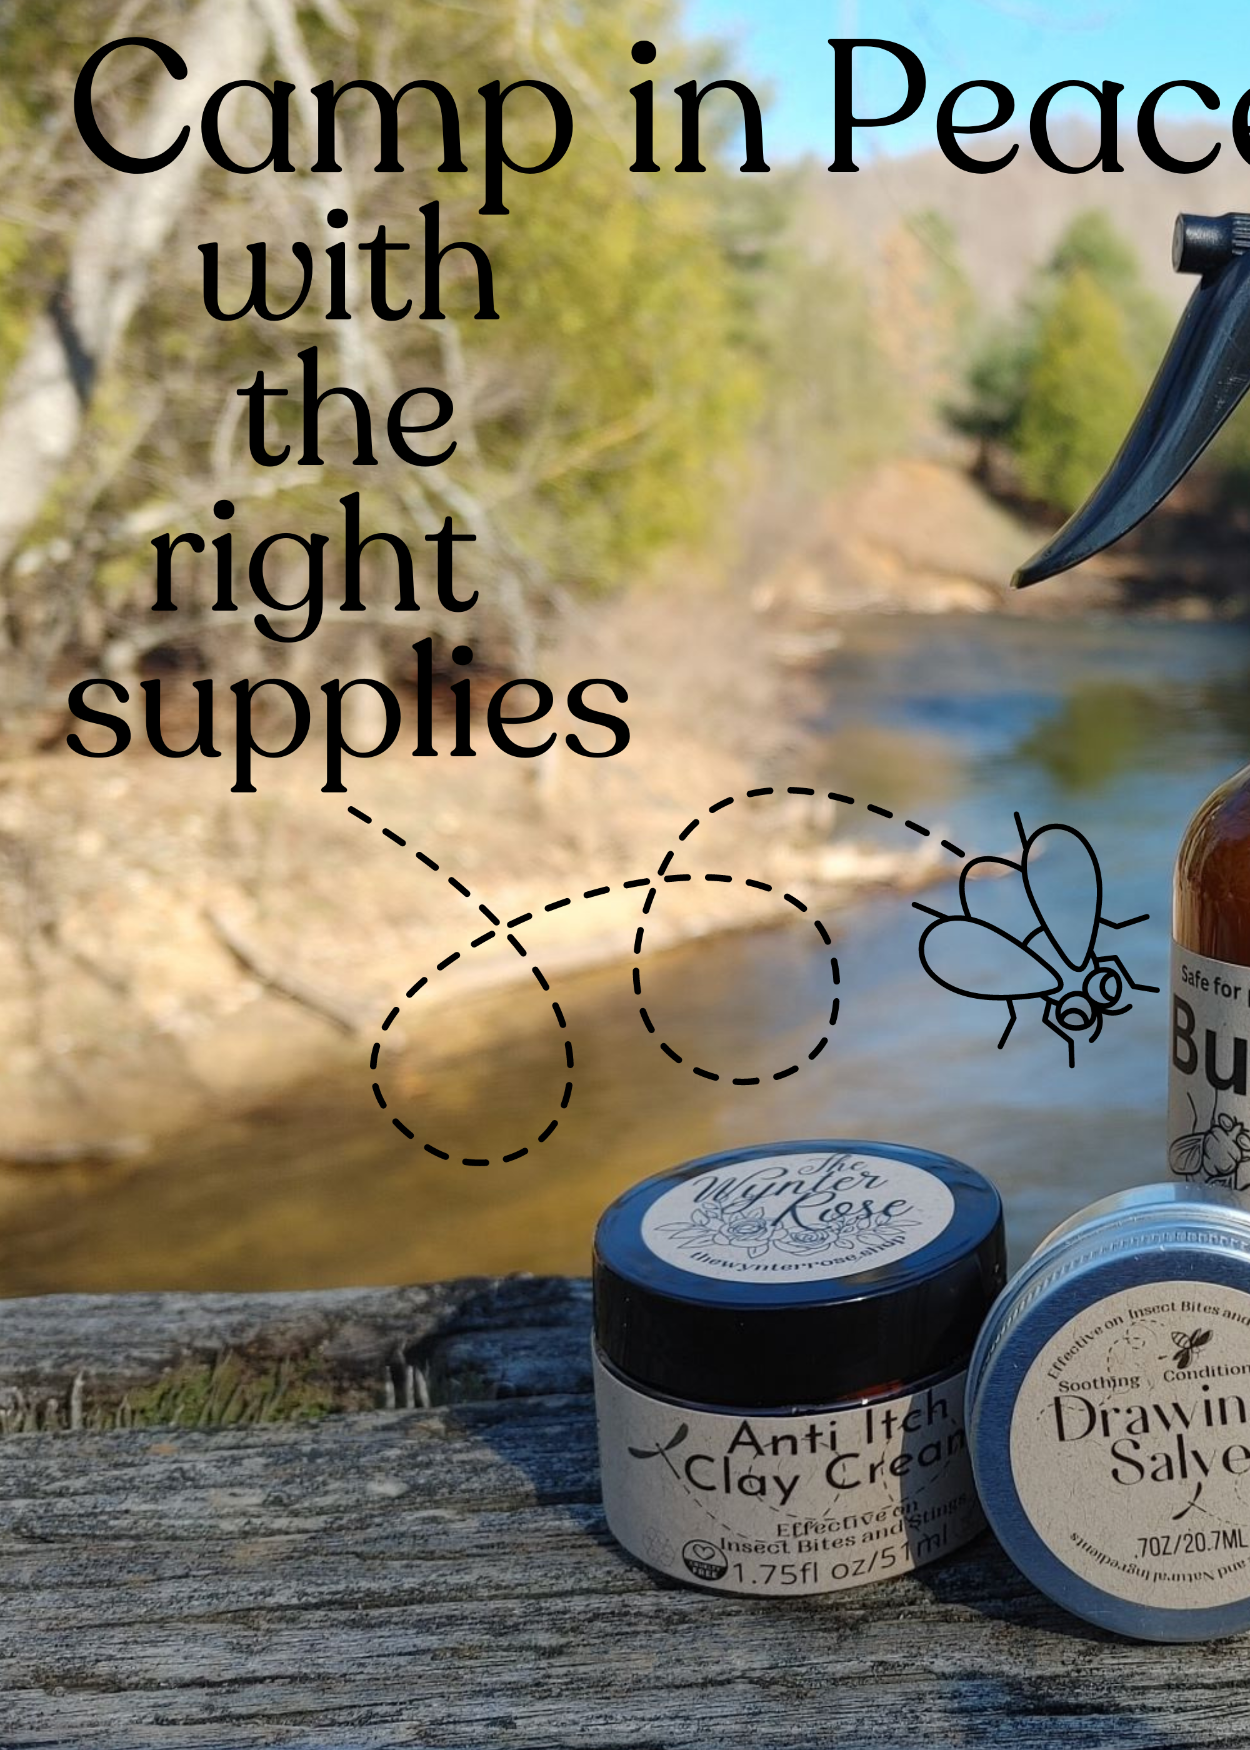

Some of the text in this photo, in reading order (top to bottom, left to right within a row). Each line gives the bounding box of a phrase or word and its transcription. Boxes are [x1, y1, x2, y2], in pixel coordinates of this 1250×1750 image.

[1181, 965, 1209, 992] Safe
[1214, 977, 1241, 1000] for
[798, 1151, 868, 1175] The
[692, 1166, 889, 1215] Wynter
[770, 1190, 914, 1231] Rose
[1047, 1326, 1103, 1380] Effective
[1105, 1316, 1125, 1330] on
[1128, 1301, 1176, 1320] Insect
[1181, 1301, 1220, 1315] Bites
[1059, 1375, 1140, 1393] Soothing
[727, 1388, 949, 1457] Anti Itch
[684, 1453, 800, 1506] Clay
[720, 1537, 790, 1554] Insect
[798, 1534, 856, 1553] Bites
[862, 1520, 903, 1543] and
[777, 1501, 919, 1538] Effective on
[733, 1562, 817, 1585] 1.75fl
[1070, 1532, 1150, 1581] Ingredients
[1218, 1561, 1246, 1579] and
[1153, 1570, 1215, 1583] Natural
